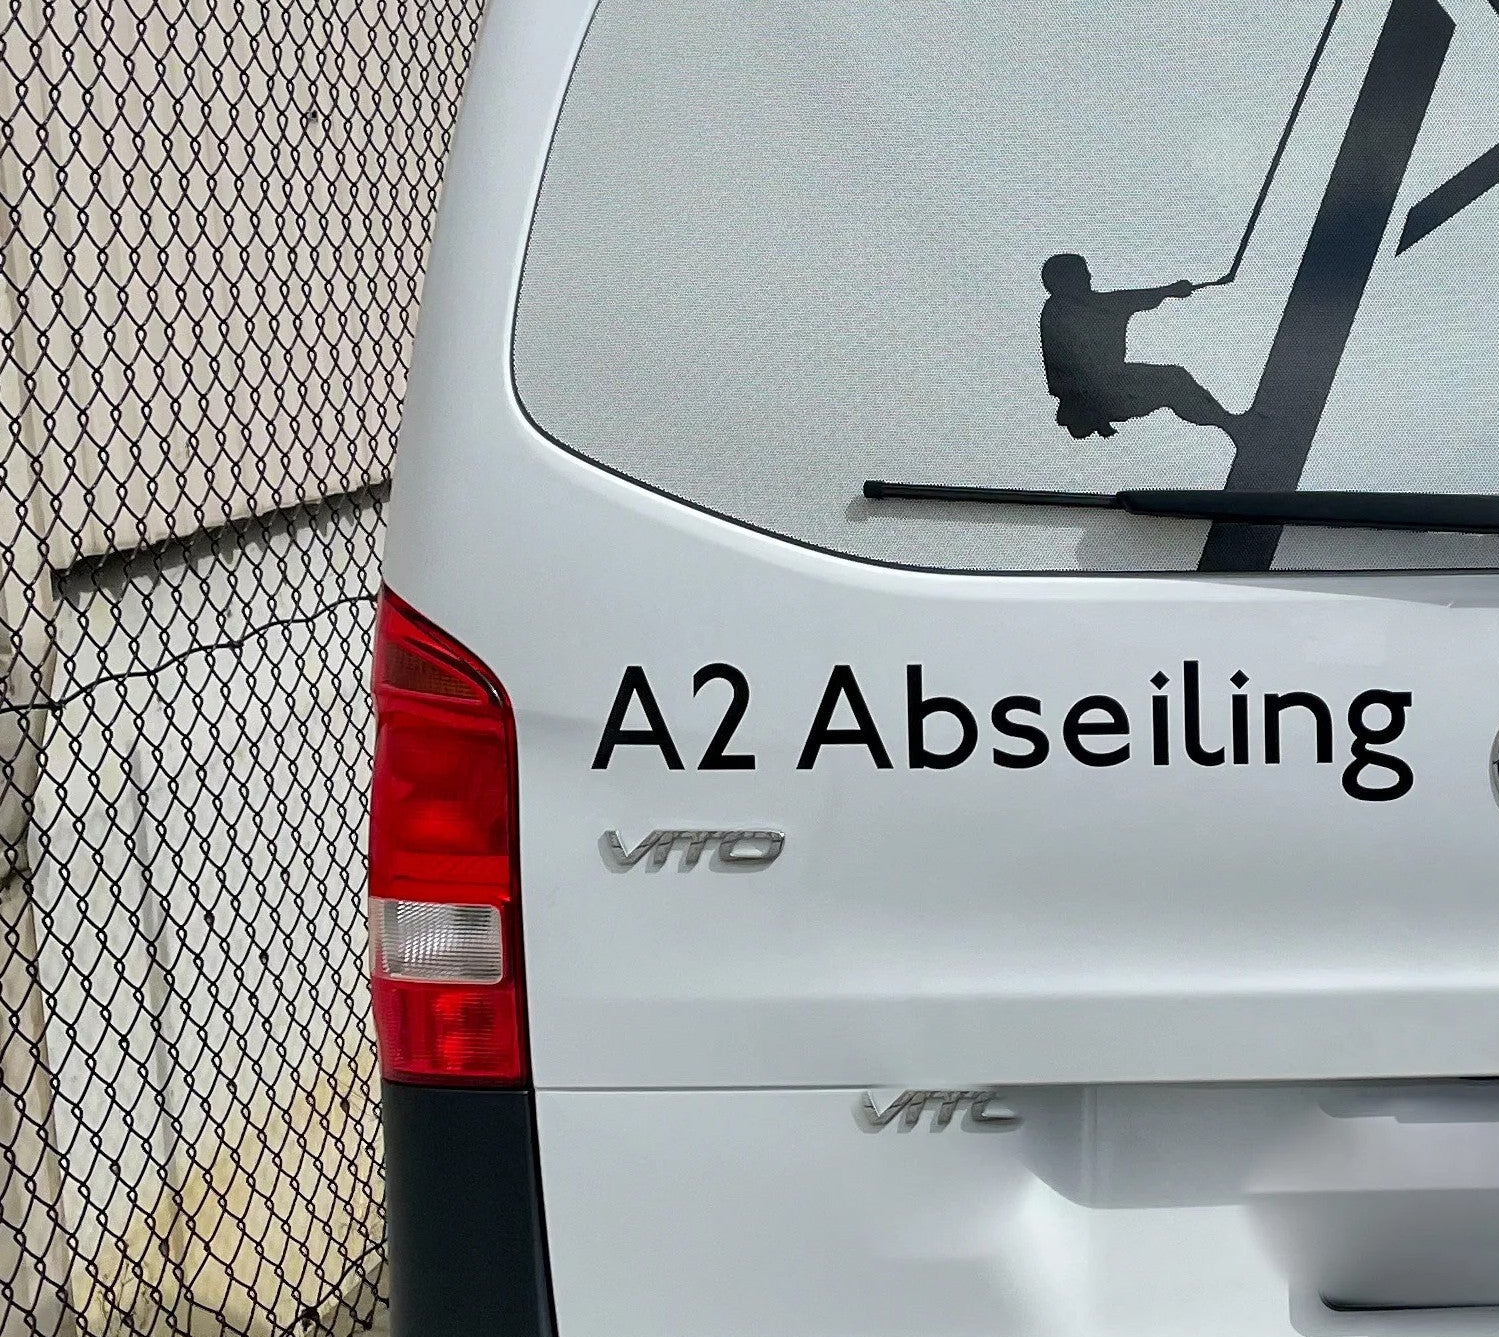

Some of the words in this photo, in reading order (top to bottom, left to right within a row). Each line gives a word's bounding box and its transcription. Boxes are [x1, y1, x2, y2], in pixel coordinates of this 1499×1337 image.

[591, 662, 757, 771] A2
[796, 660, 1415, 802] Abseiling
[598, 829, 786, 873] VITO
